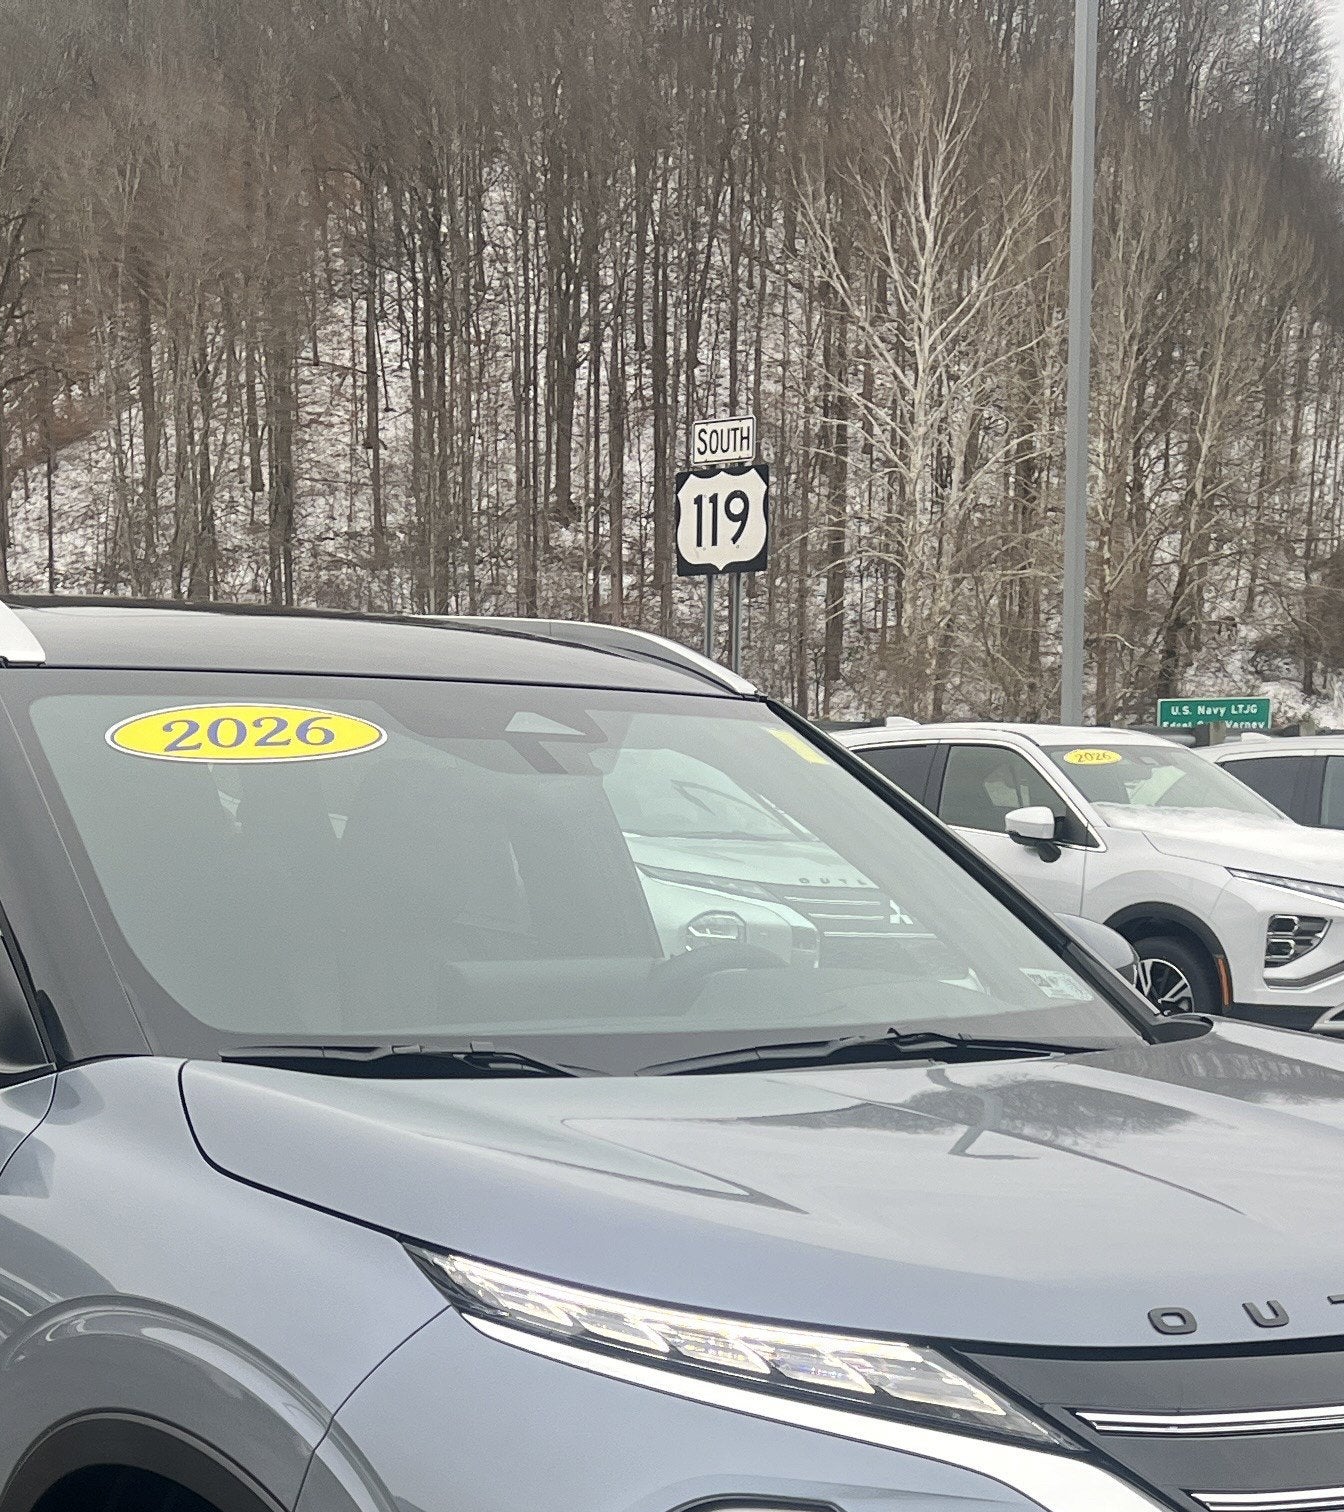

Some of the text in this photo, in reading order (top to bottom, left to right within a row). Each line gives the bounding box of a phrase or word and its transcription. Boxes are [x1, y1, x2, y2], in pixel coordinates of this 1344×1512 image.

[697, 427, 751, 455] SOUTH
[693, 489, 750, 548] 119
[1170, 704, 1258, 717] U.S. Navy LTJG
[162, 715, 336, 753] 2026
